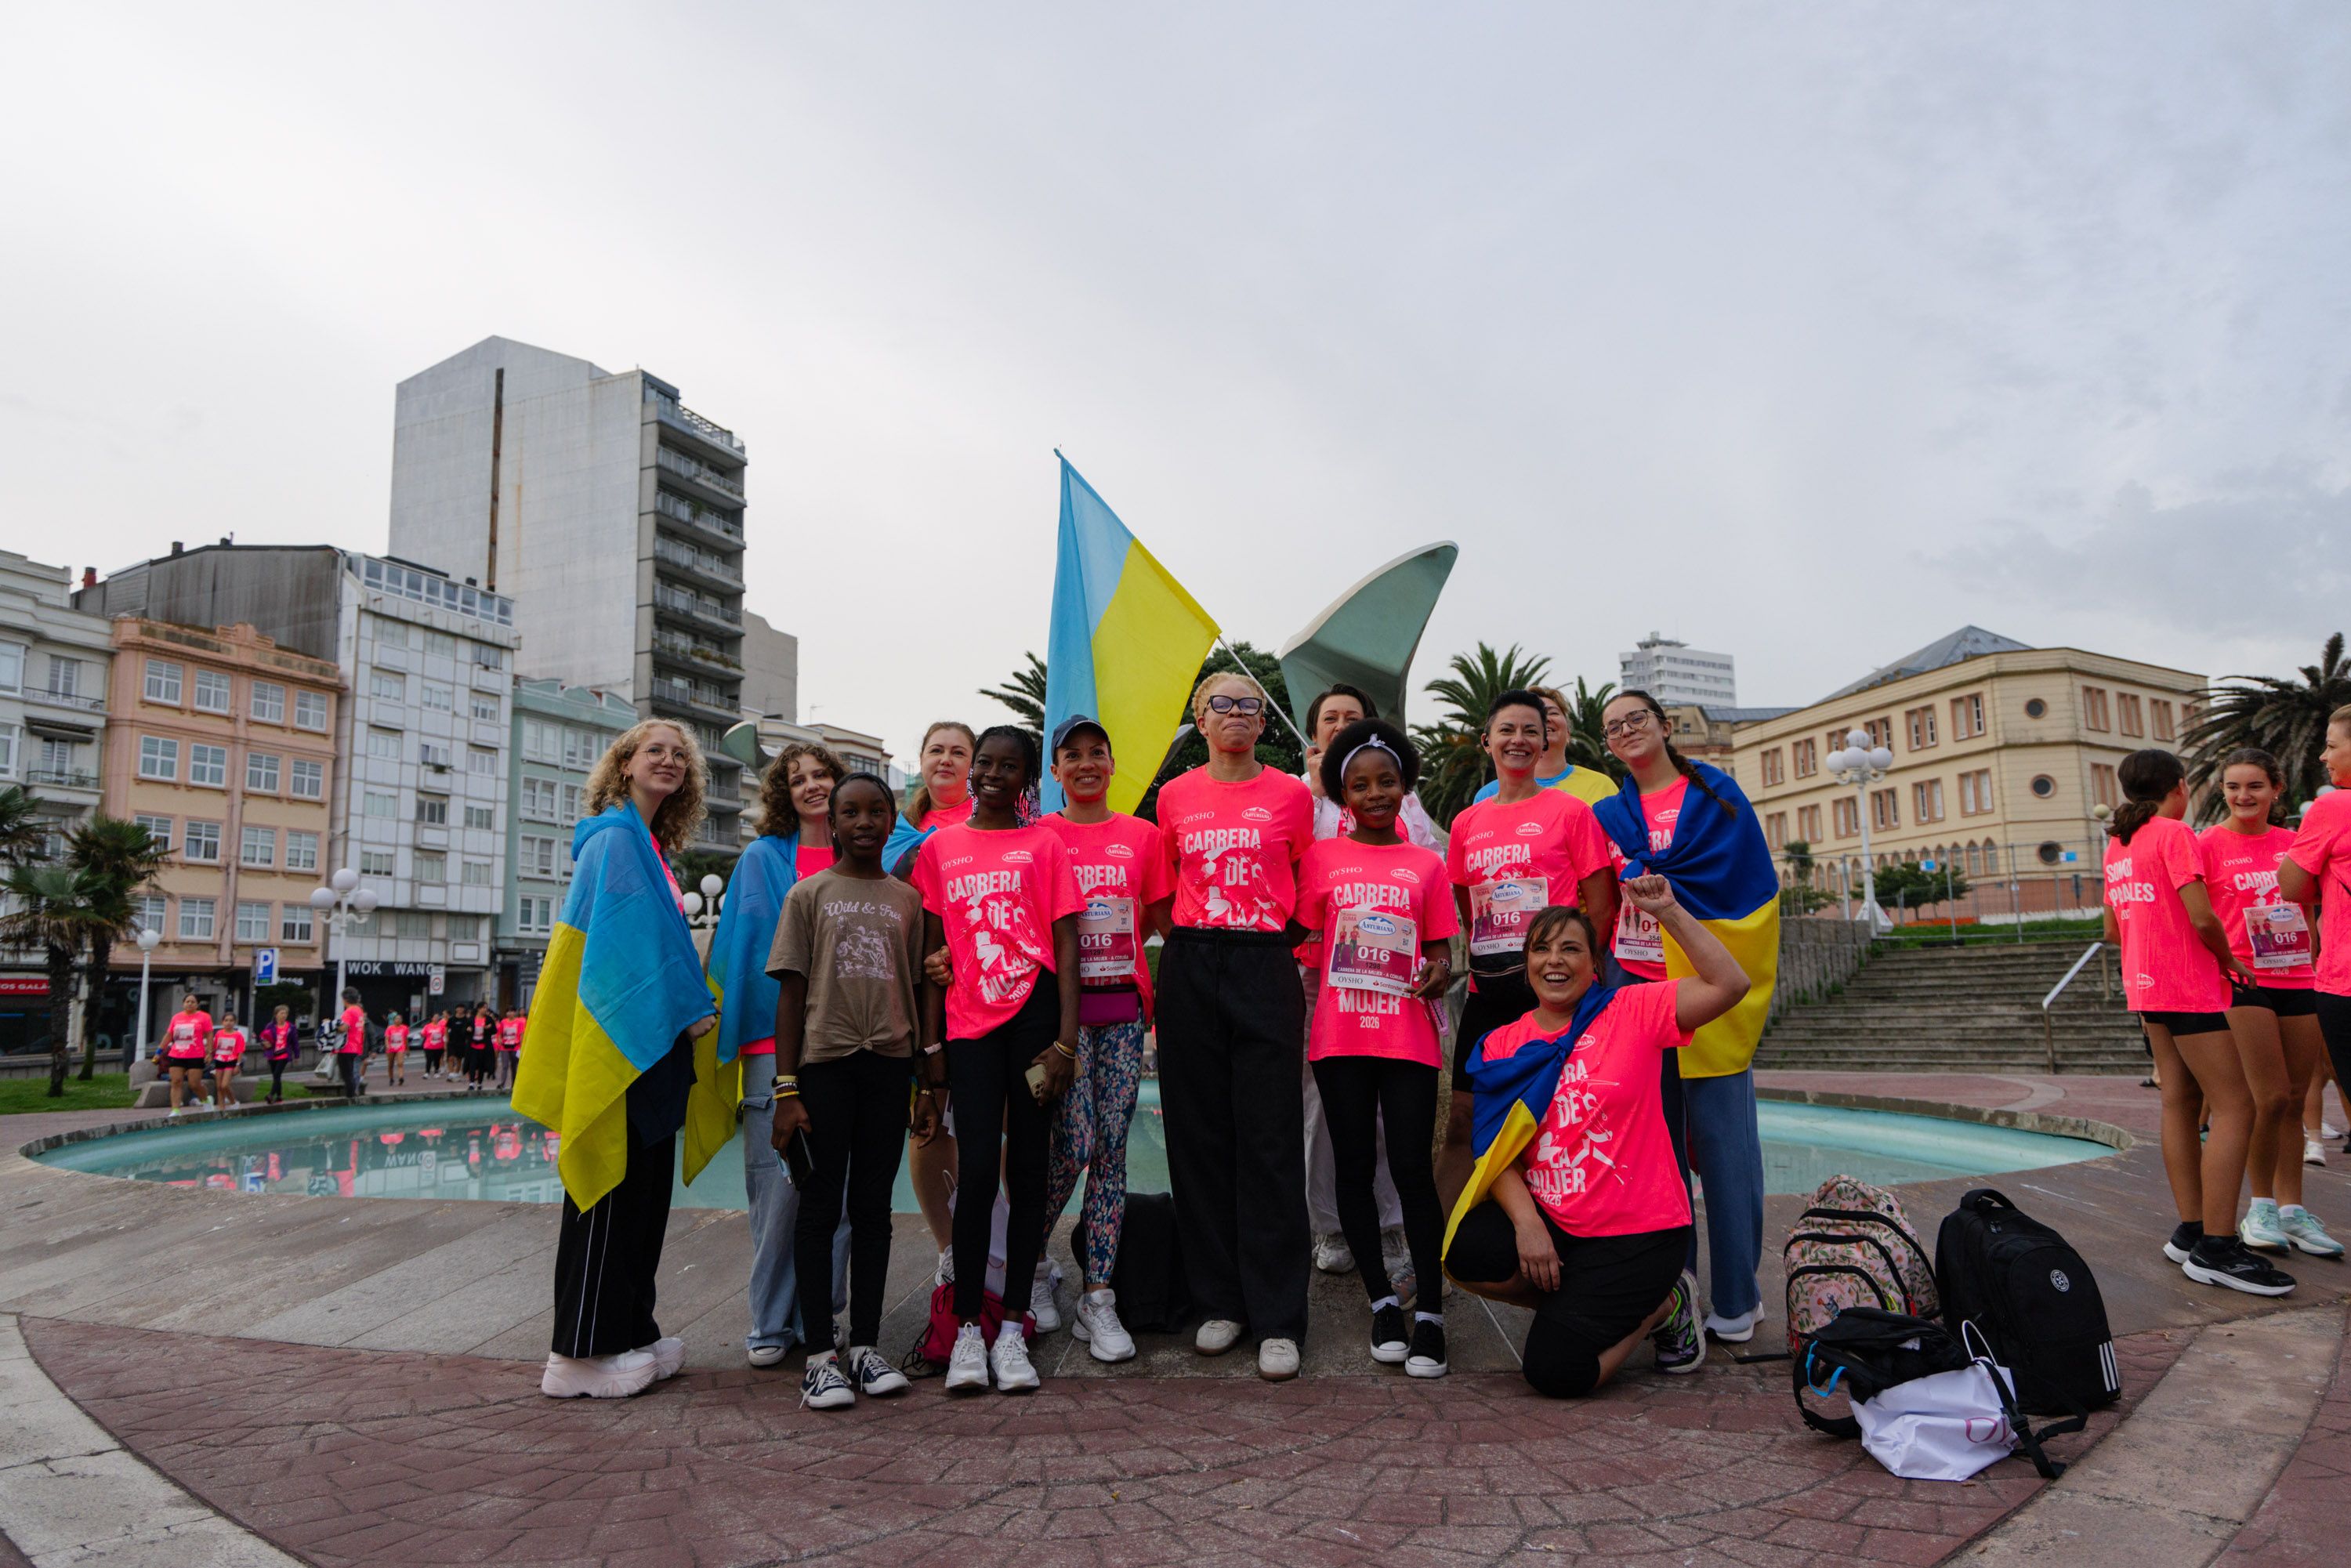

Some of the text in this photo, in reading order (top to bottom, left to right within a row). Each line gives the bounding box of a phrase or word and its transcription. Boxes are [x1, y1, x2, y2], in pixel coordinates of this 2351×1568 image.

[1183, 811, 1214, 824] OYSHO
[1244, 811, 1270, 820] ASTURIANA
[1185, 828, 1260, 854] CARRERA
[1467, 831, 1494, 845] OYSHO
[941, 856, 973, 871] OYSHO
[1467, 843, 1531, 873] CARRERA
[2223, 856, 2253, 867] OYSHO
[1073, 865, 1127, 887] RRERA
[1225, 856, 1249, 885] DE
[1329, 867, 1362, 878] OYSHO
[947, 870, 1021, 903] CARRERA
[1334, 882, 1410, 907] CARRERA
[824, 900, 902, 922] Wild & Free
[1227, 904, 1247, 926] LA
[1493, 911, 1521, 926] 016
[1361, 922, 1393, 932] ASTURIANA
[1642, 920, 1660, 932] 01
[1080, 933, 1113, 947] 016
[2274, 932, 2298, 943] 016
[1357, 946, 1390, 962] 016
[1478, 943, 1500, 951] OYSHO
[258, 951, 273, 974] P
[347, 962, 382, 975] WOK
[1338, 976, 1364, 984] OYSHO
[1339, 989, 1400, 1015] MUJER
[1360, 1016, 1380, 1029] 2026
